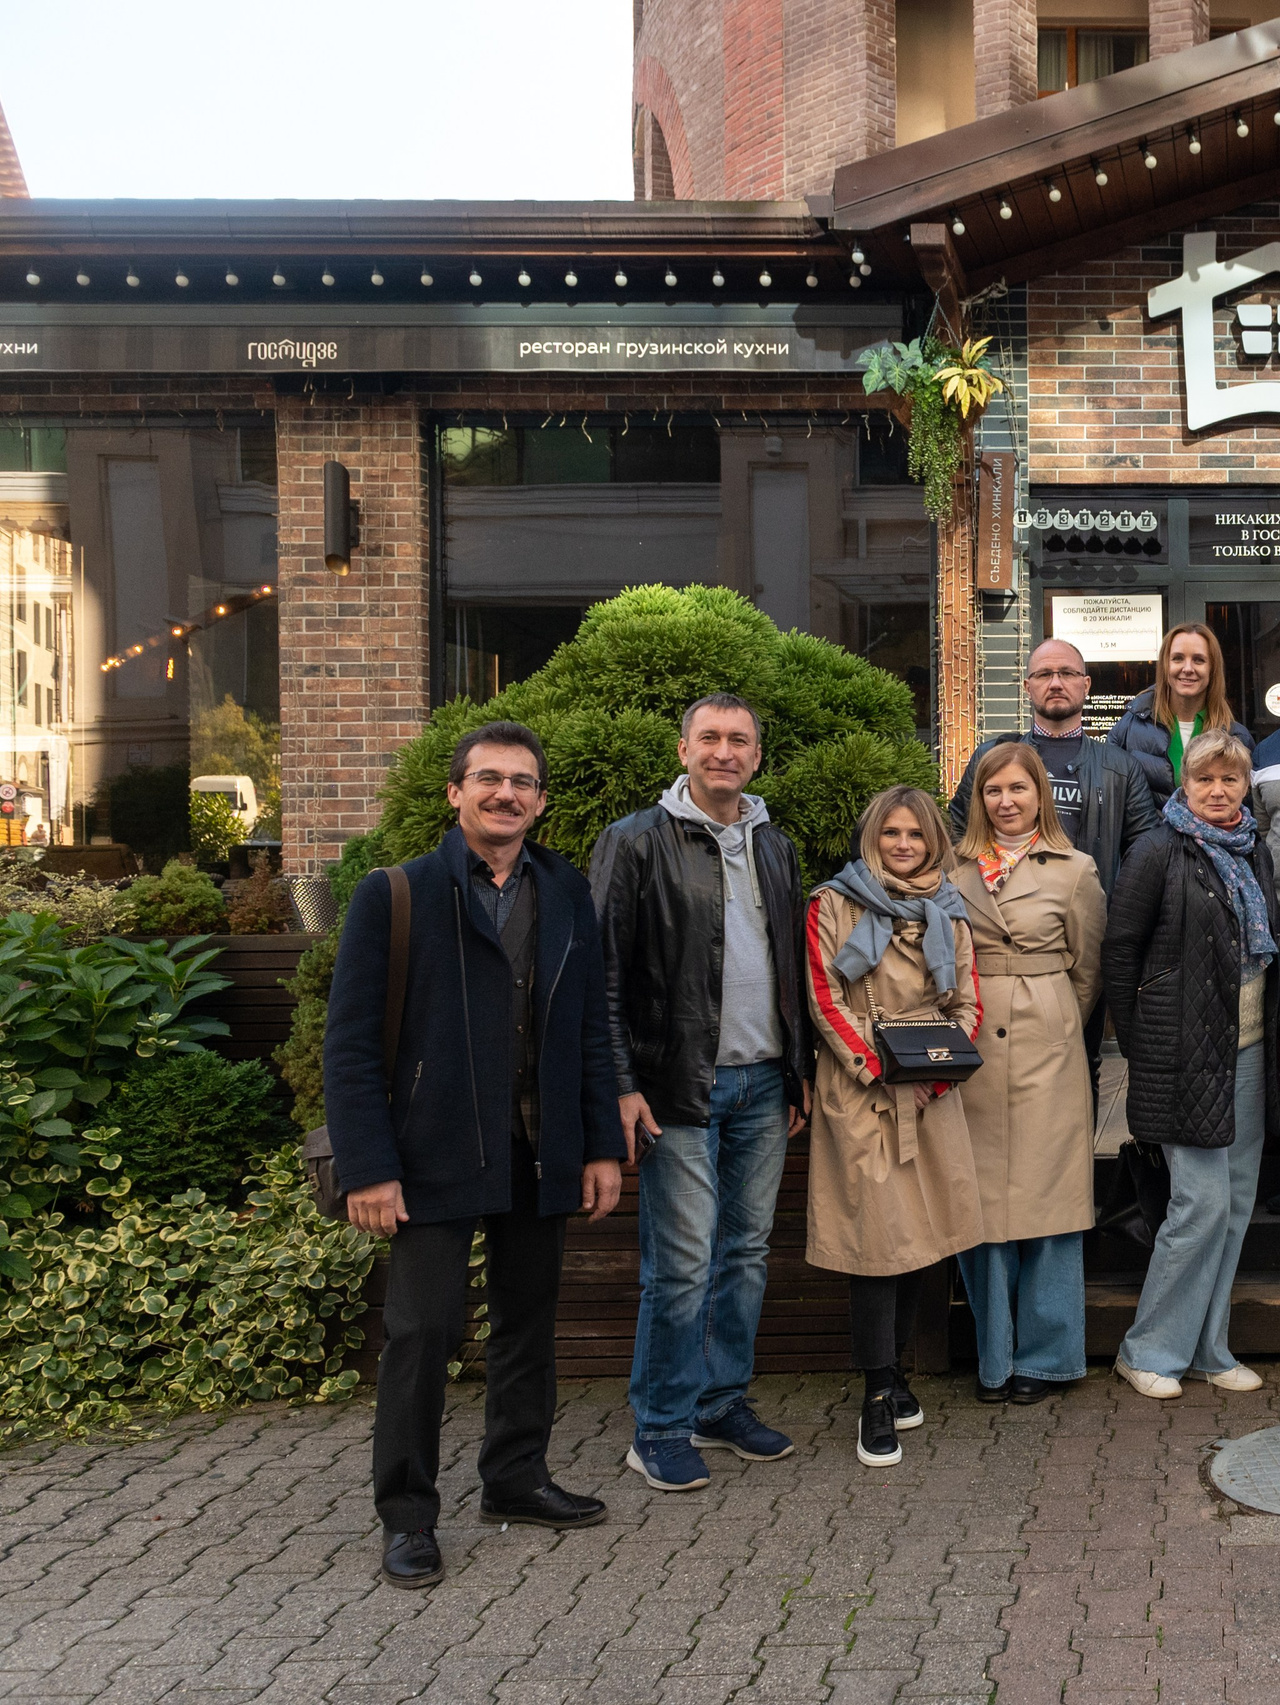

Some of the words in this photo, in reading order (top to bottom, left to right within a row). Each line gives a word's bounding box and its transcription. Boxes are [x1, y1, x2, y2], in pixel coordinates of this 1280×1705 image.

[0, 343, 38, 354] хни
[520, 341, 610, 358] ресторан
[616, 339, 727, 358] грузинской
[733, 341, 789, 358] кухни
[992, 458, 1002, 519] ХИНКАЛИ
[1241, 529, 1250, 541] В
[990, 523, 1001, 583] СЪЕДЕНО
[1212, 545, 1271, 557] ТОЛЬКО
[1083, 597, 1131, 605] ПОЖАЛУЙСТА,
[1062, 606, 1108, 614] СОБЛЮДАЙТЕ
[1109, 606, 1152, 614] ДИСТАНЦИЮ
